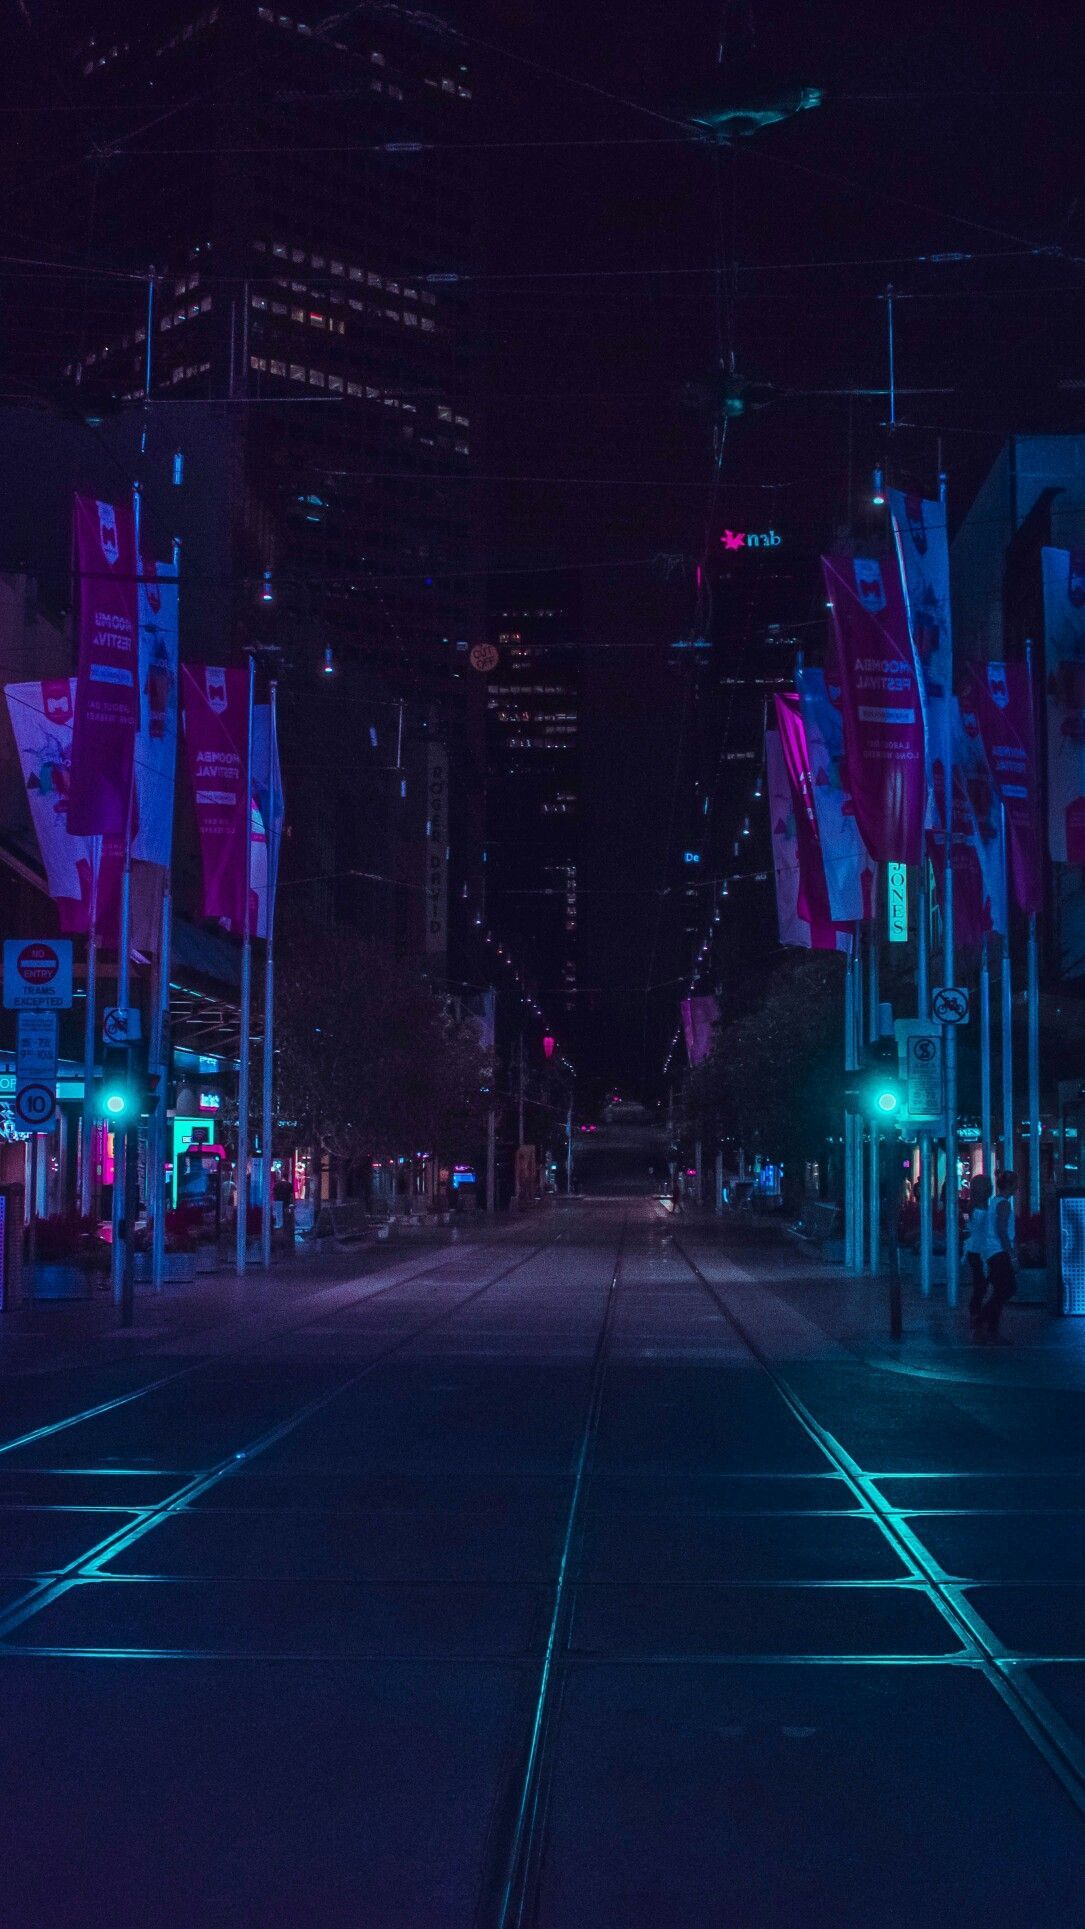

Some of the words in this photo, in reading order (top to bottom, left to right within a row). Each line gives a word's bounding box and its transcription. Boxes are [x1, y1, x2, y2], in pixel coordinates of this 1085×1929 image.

[747, 530, 782, 547] nab
[891, 862, 905, 935] JONES
[31, 950, 45, 958] NO
[24, 969, 54, 978] ENTRY
[23, 986, 56, 995] TRAMS
[14, 997, 64, 1006] EXCEPTED
[27, 1095, 46, 1113] 10
